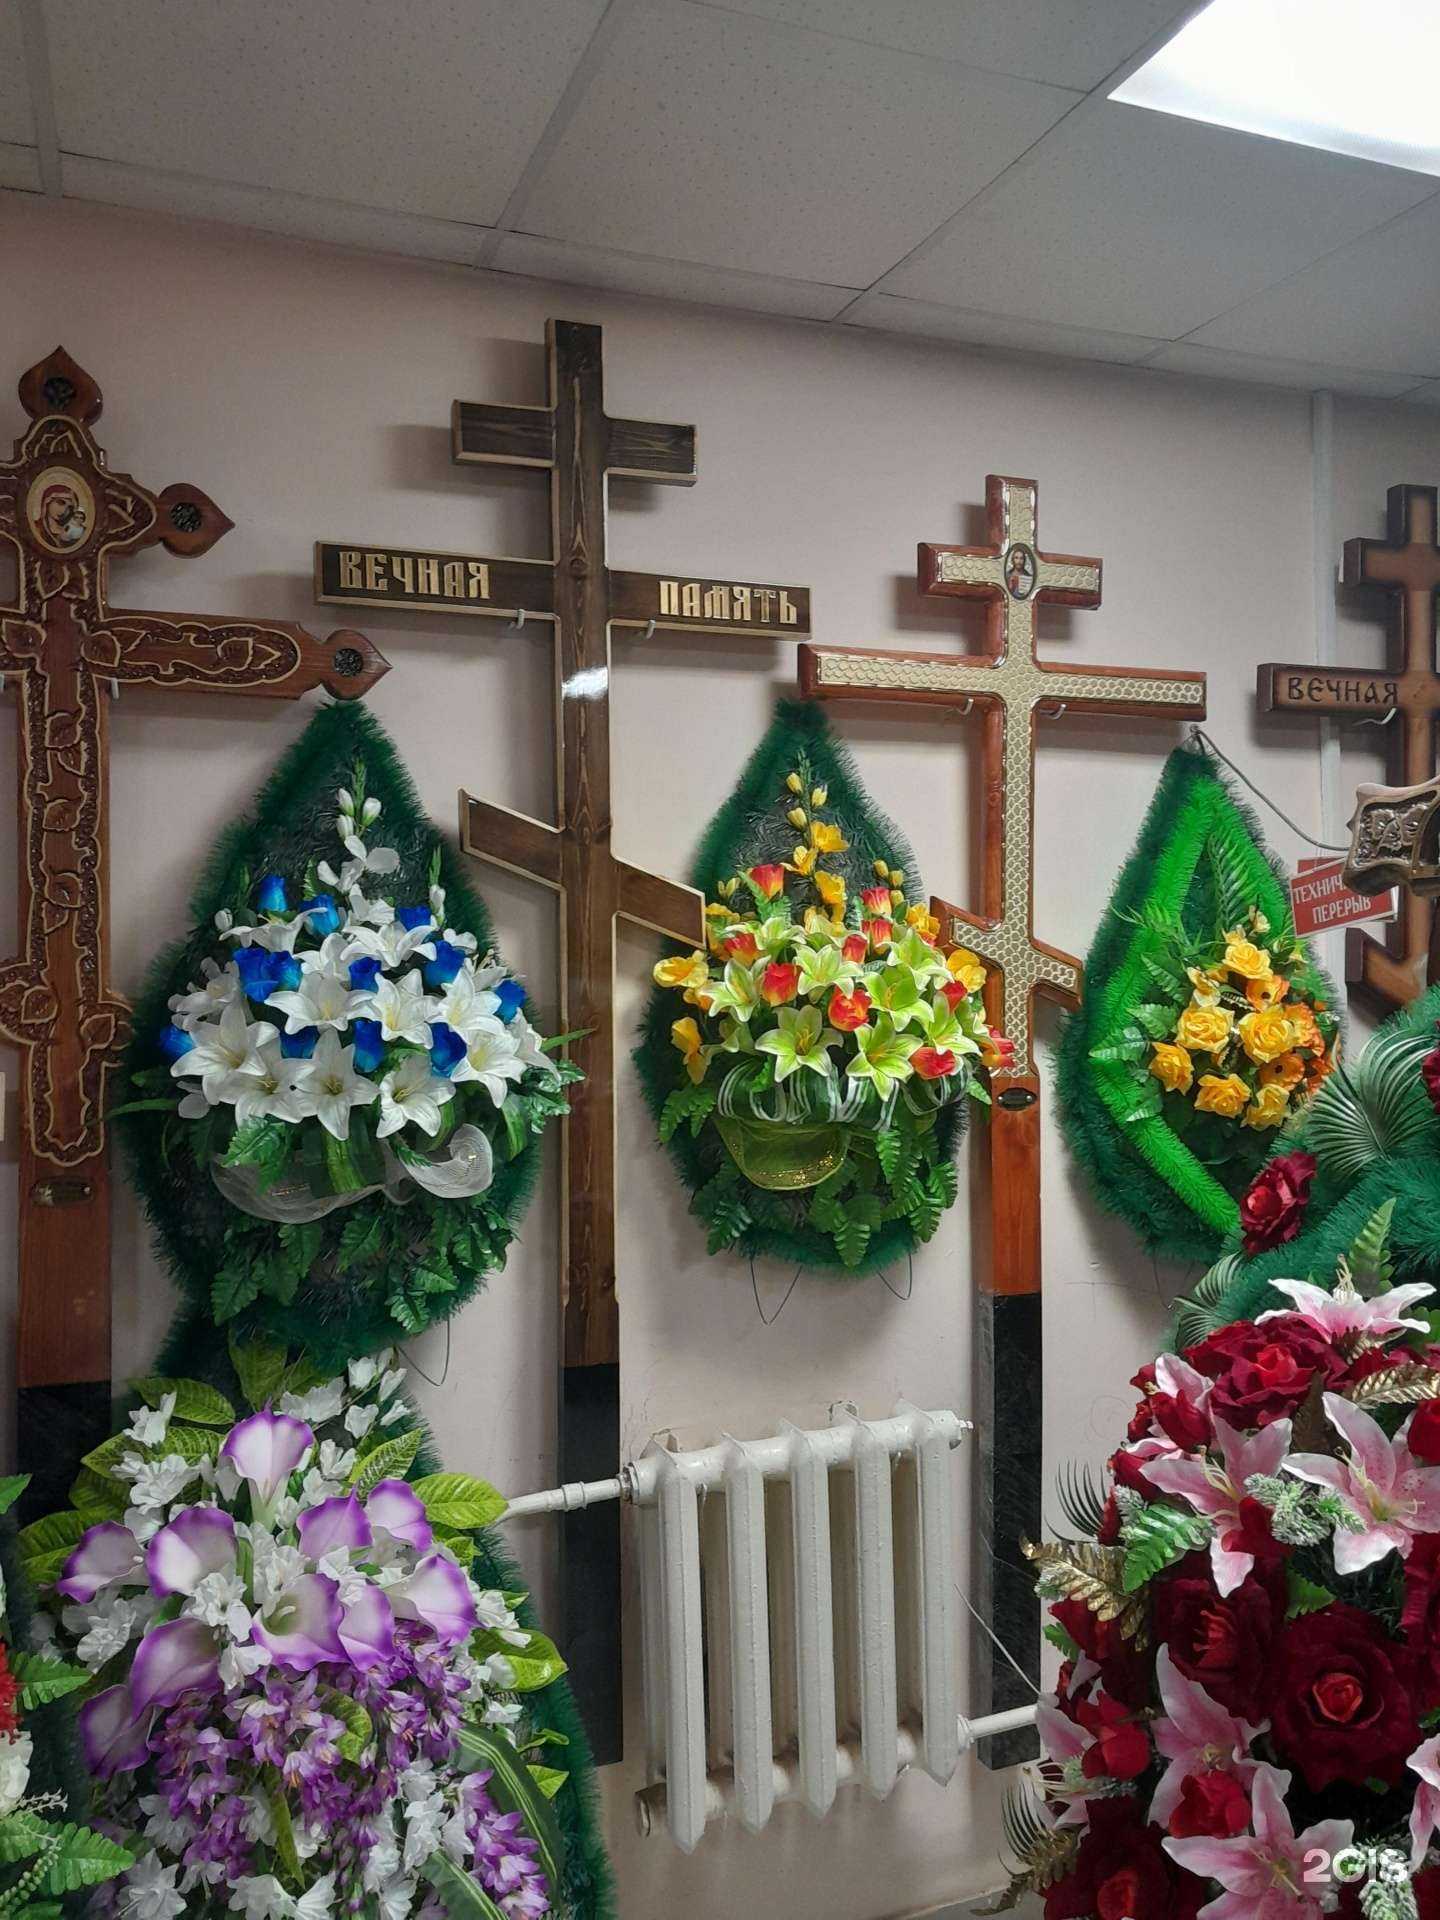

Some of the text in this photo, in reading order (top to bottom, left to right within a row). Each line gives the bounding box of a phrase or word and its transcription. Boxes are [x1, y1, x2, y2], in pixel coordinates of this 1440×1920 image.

[338, 550, 798, 625] ВЕЧНАЯ ПАМЯТЬ
[1293, 872, 1348, 905] ТЕХНИЧ
[1312, 894, 1372, 924] ПЕРЕРЫВ
